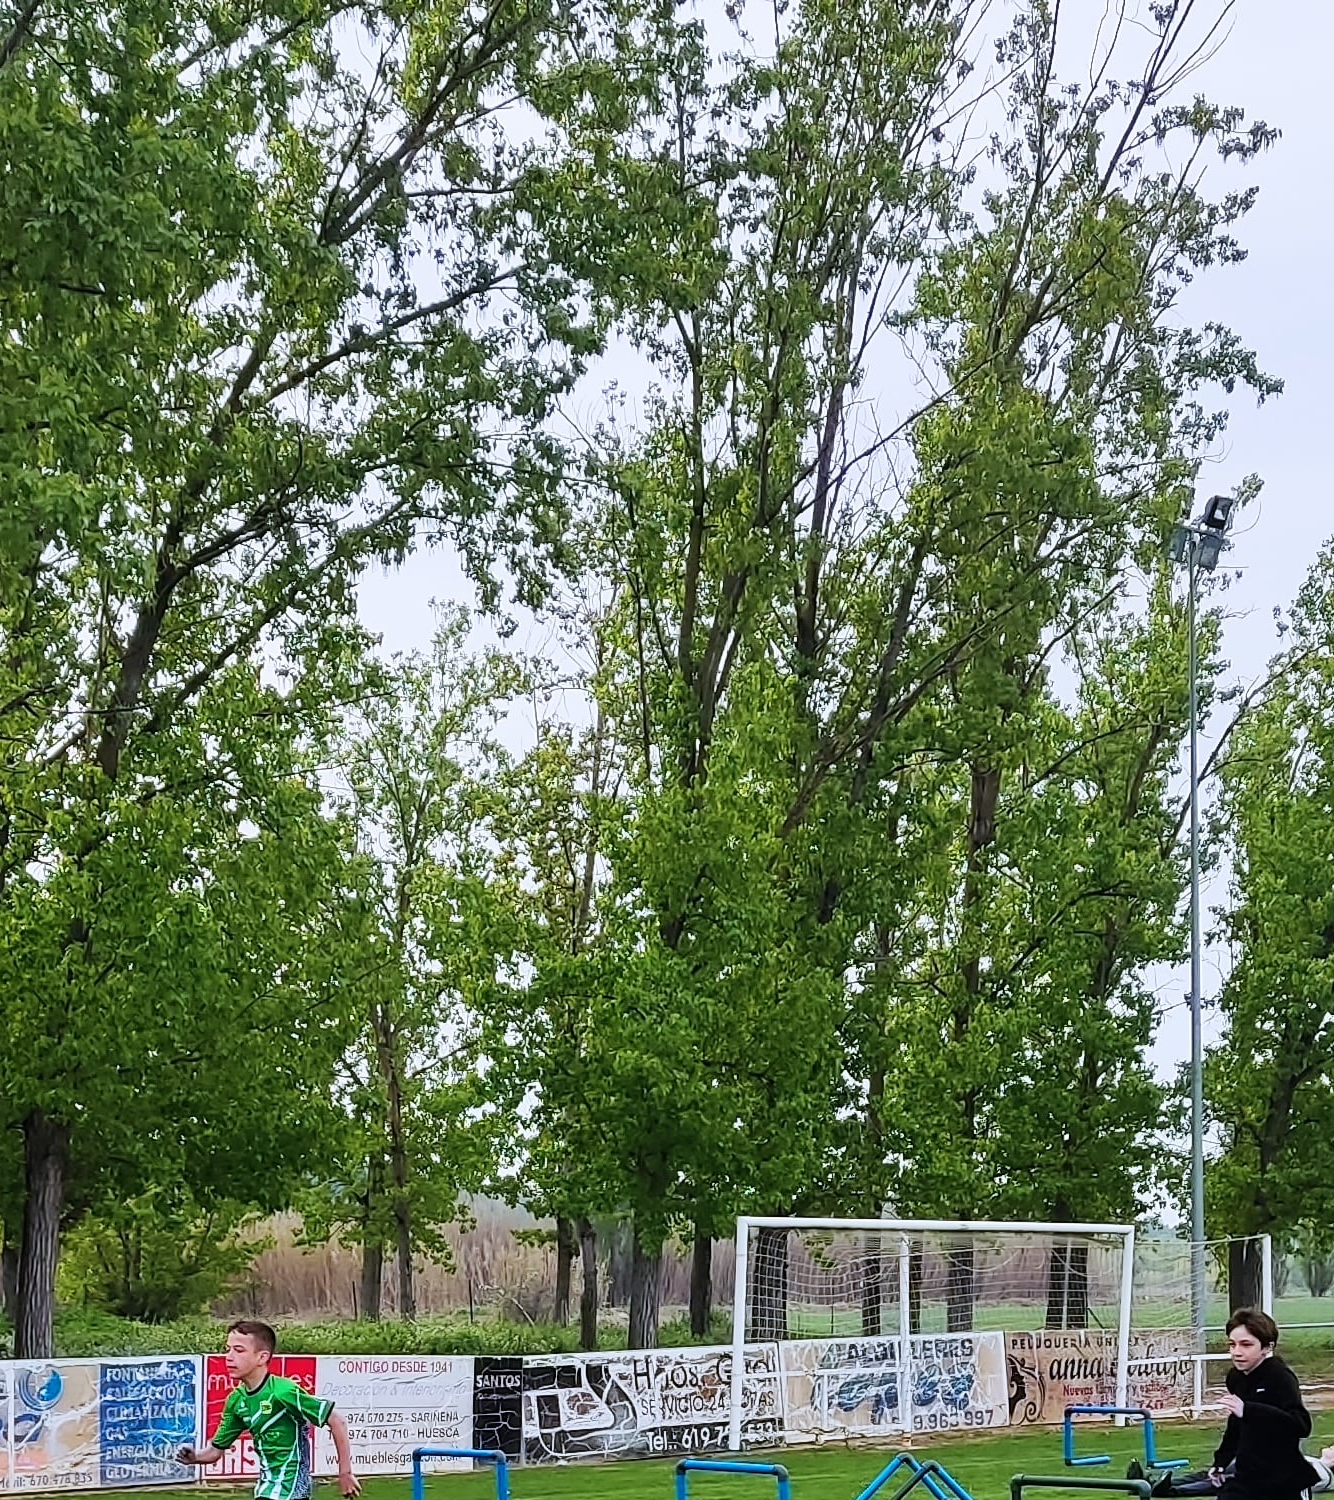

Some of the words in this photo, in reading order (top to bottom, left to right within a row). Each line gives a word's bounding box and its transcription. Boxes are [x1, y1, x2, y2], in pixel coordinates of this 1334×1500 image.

[339, 1360, 388, 1373] CONTIGO
[392, 1360, 427, 1373] DESDE
[476, 1374, 521, 1388] SANTOS
[387, 1412, 403, 1423] 275
[964, 1409, 994, 1426] 997
[348, 1429, 366, 1440] 974
[371, 1428, 388, 1440] 704
[391, 1428, 409, 1439] 710
[417, 1427, 460, 1439] HUESCA
[681, 1427, 711, 1448] 619
